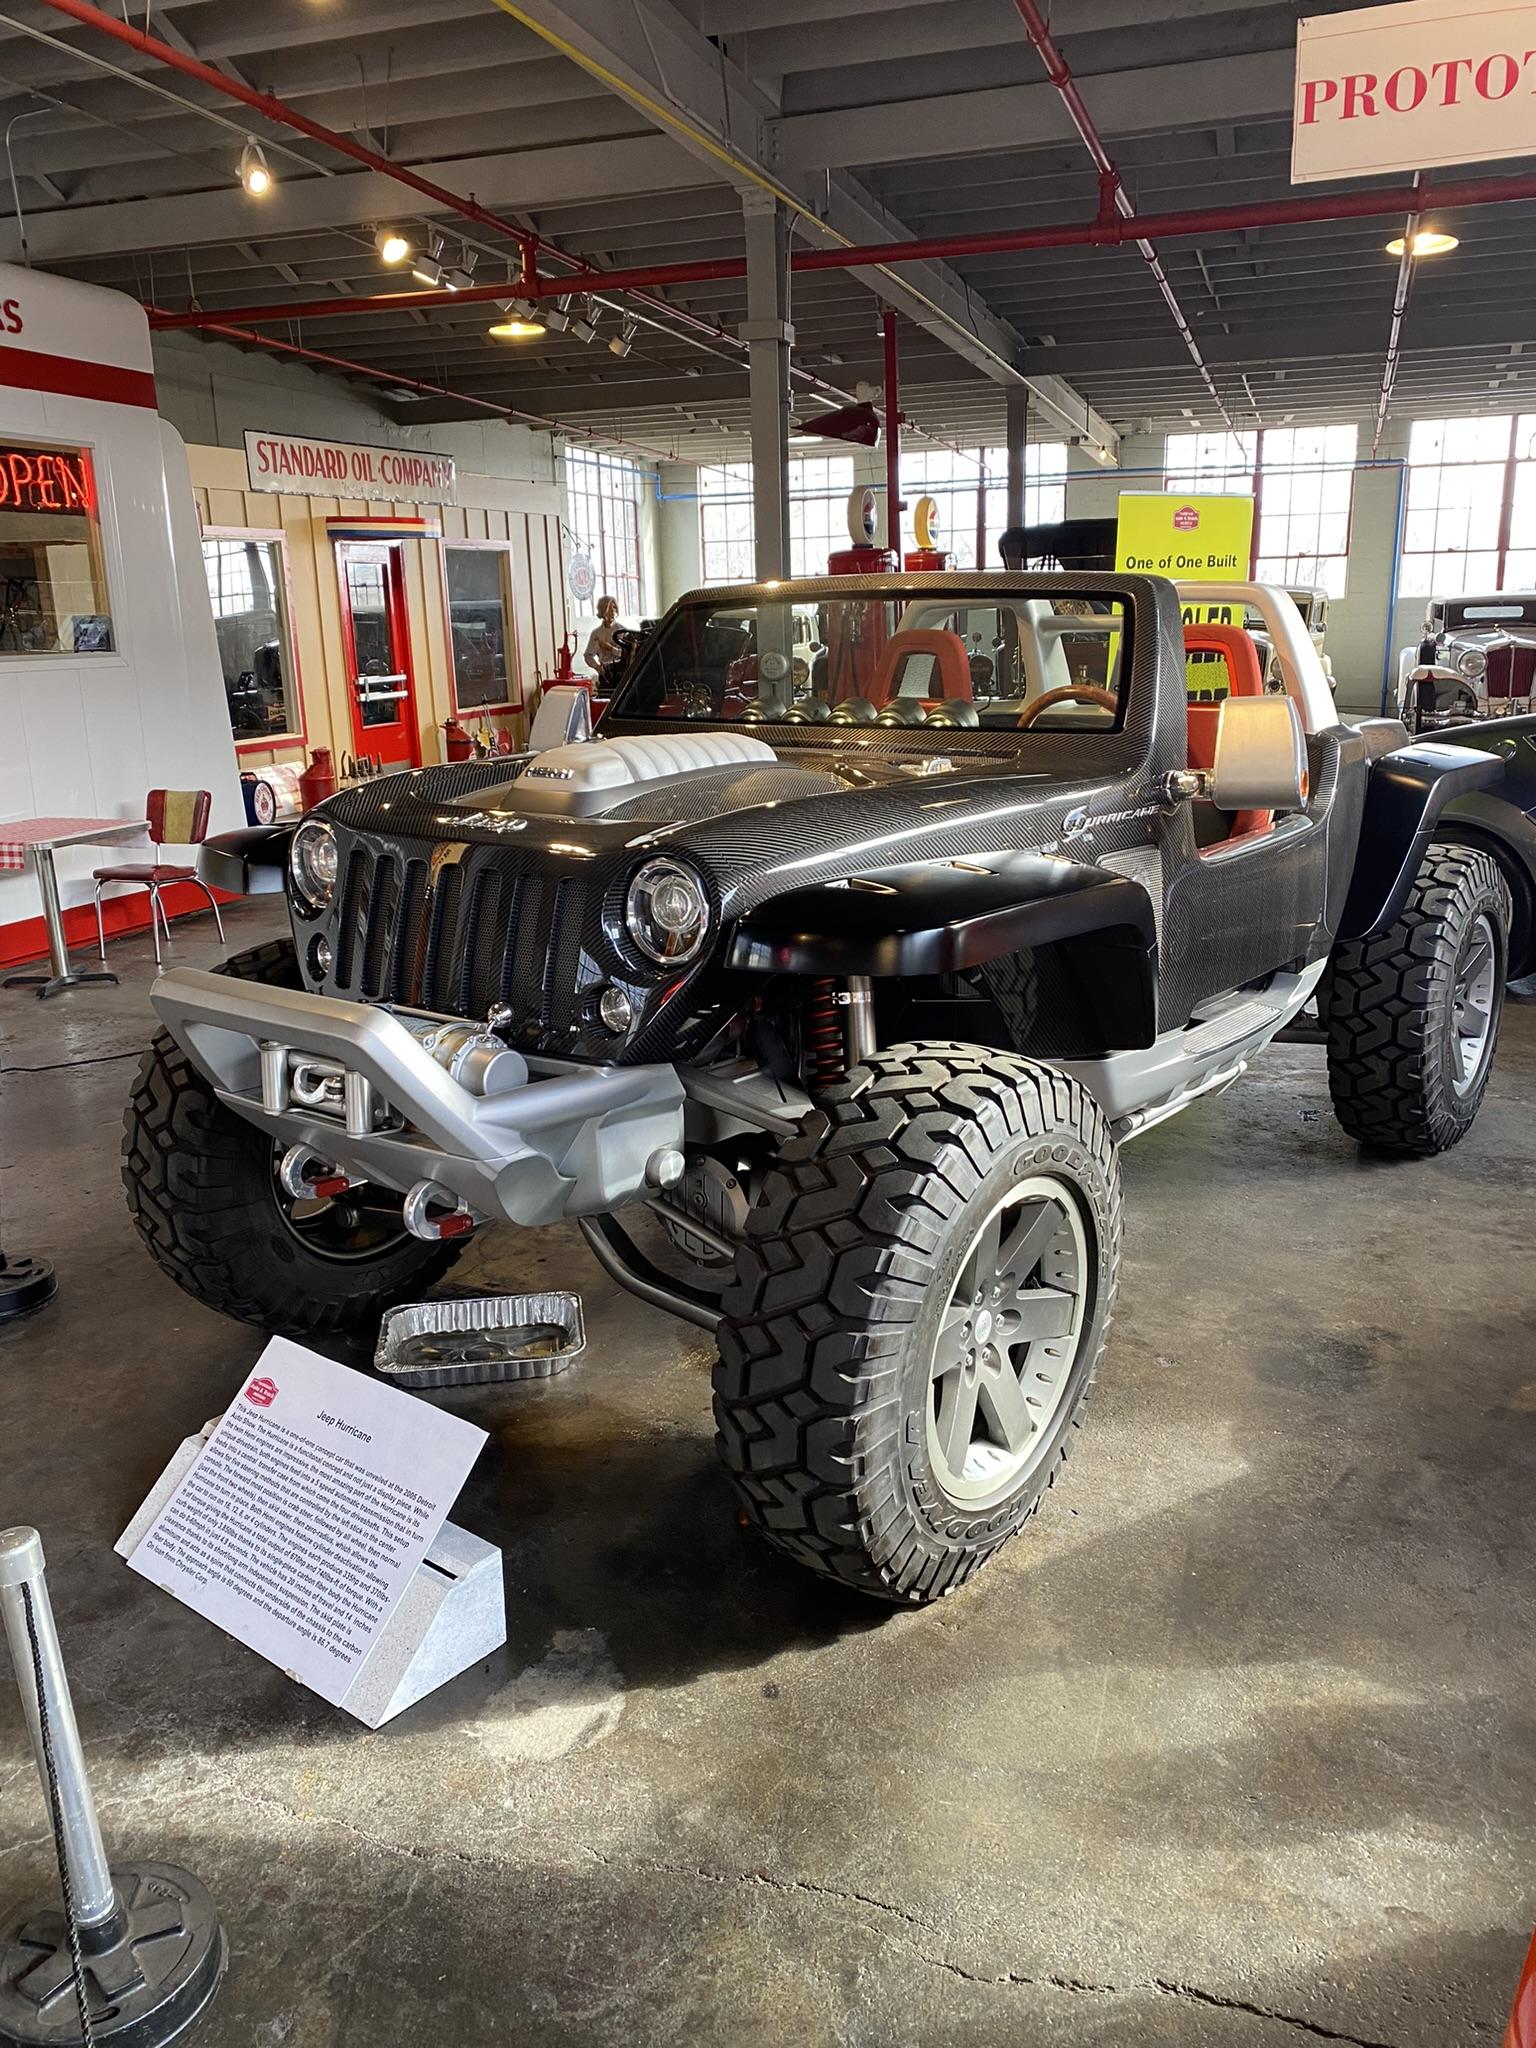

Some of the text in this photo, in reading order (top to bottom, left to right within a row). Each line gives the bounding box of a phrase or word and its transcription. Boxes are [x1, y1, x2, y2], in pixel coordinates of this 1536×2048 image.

[256, 440, 348, 480] STANDARD
[352, 452, 377, 482] OIL
[1126, 555, 1238, 569] One of One Built
[316, 1409, 371, 1443] Jeep Hurricane
